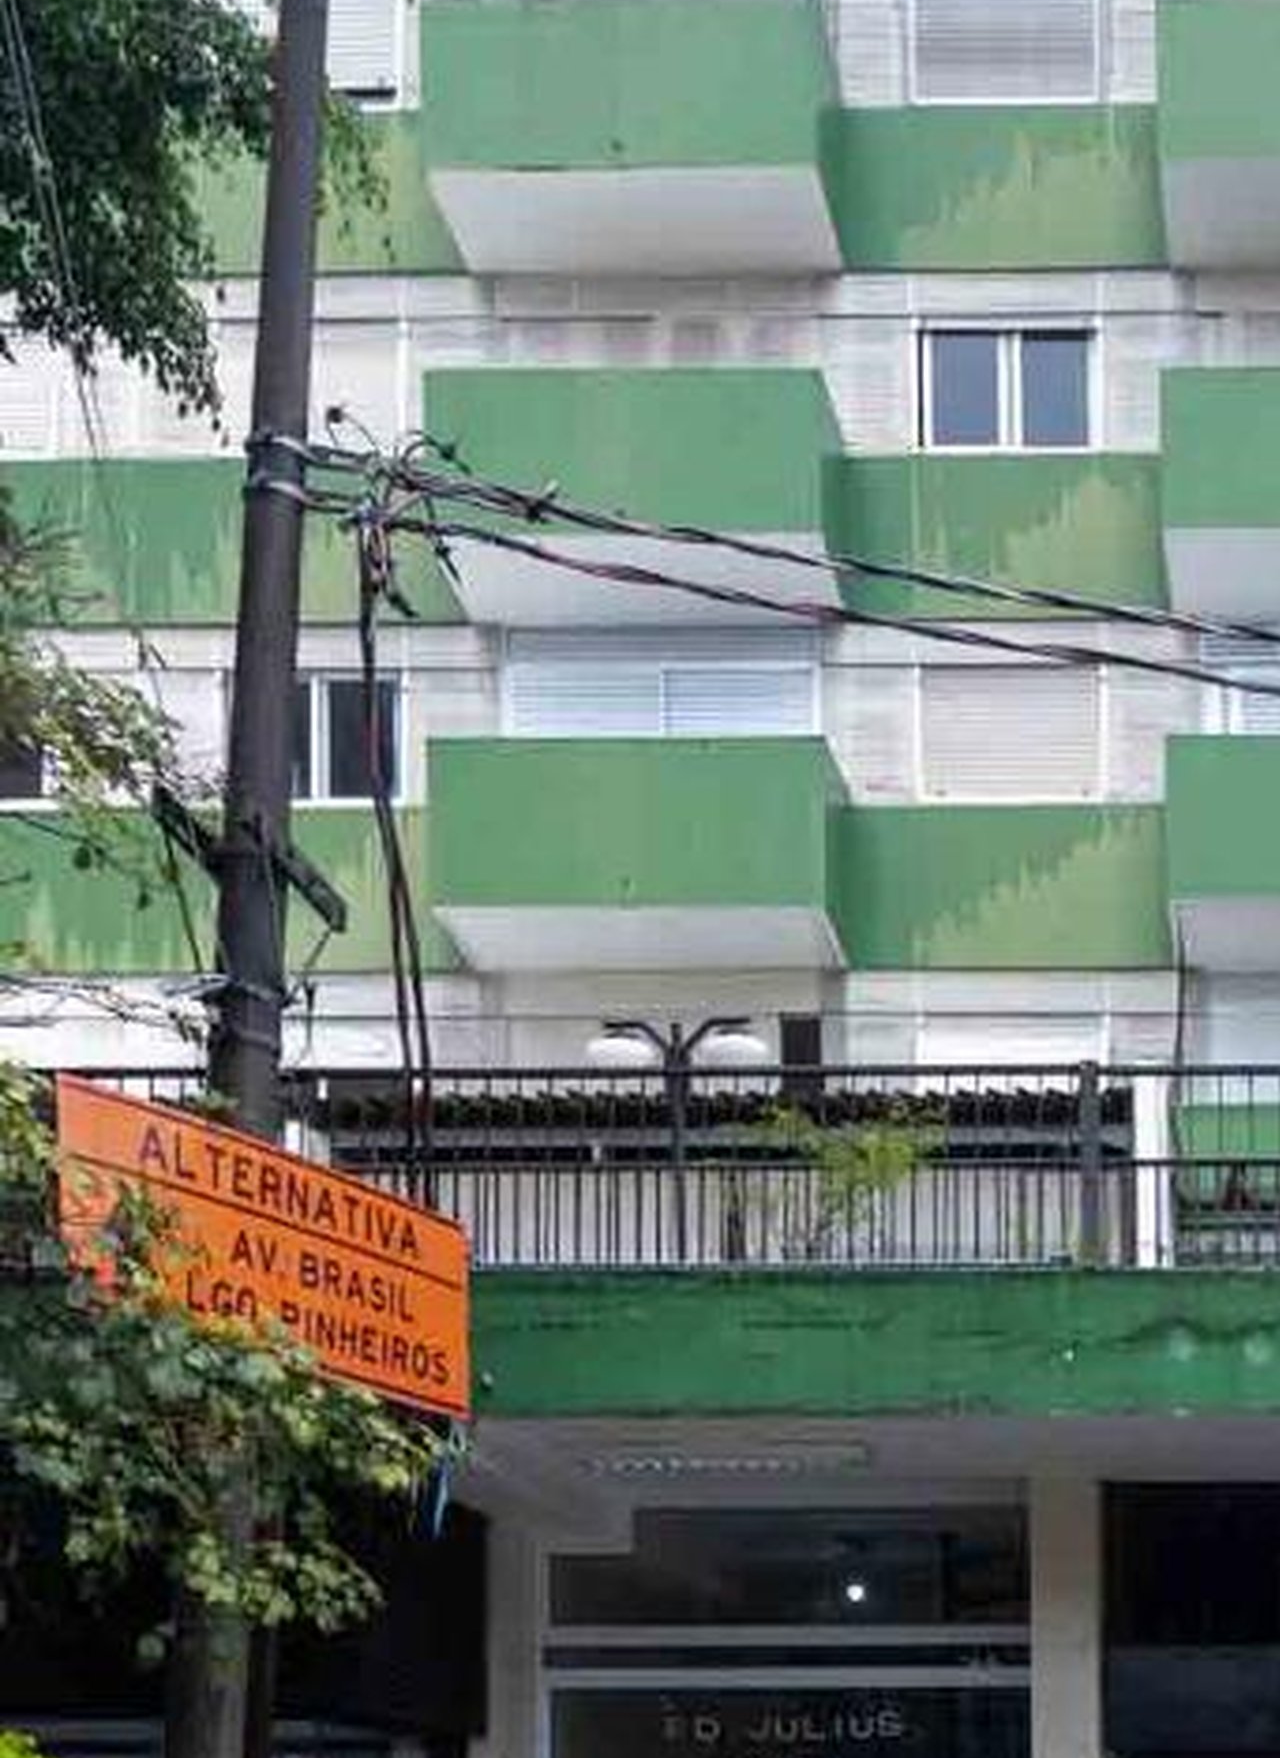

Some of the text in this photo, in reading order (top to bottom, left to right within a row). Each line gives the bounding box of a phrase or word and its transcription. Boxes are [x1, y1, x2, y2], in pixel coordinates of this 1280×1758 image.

[139, 1125, 418, 1258] ALTERNATIVA
[187, 1270, 449, 1385] LGO PINHEIROS
[300, 1252, 413, 1323] BRASIL
[747, 1707, 902, 1740] JULIUS
